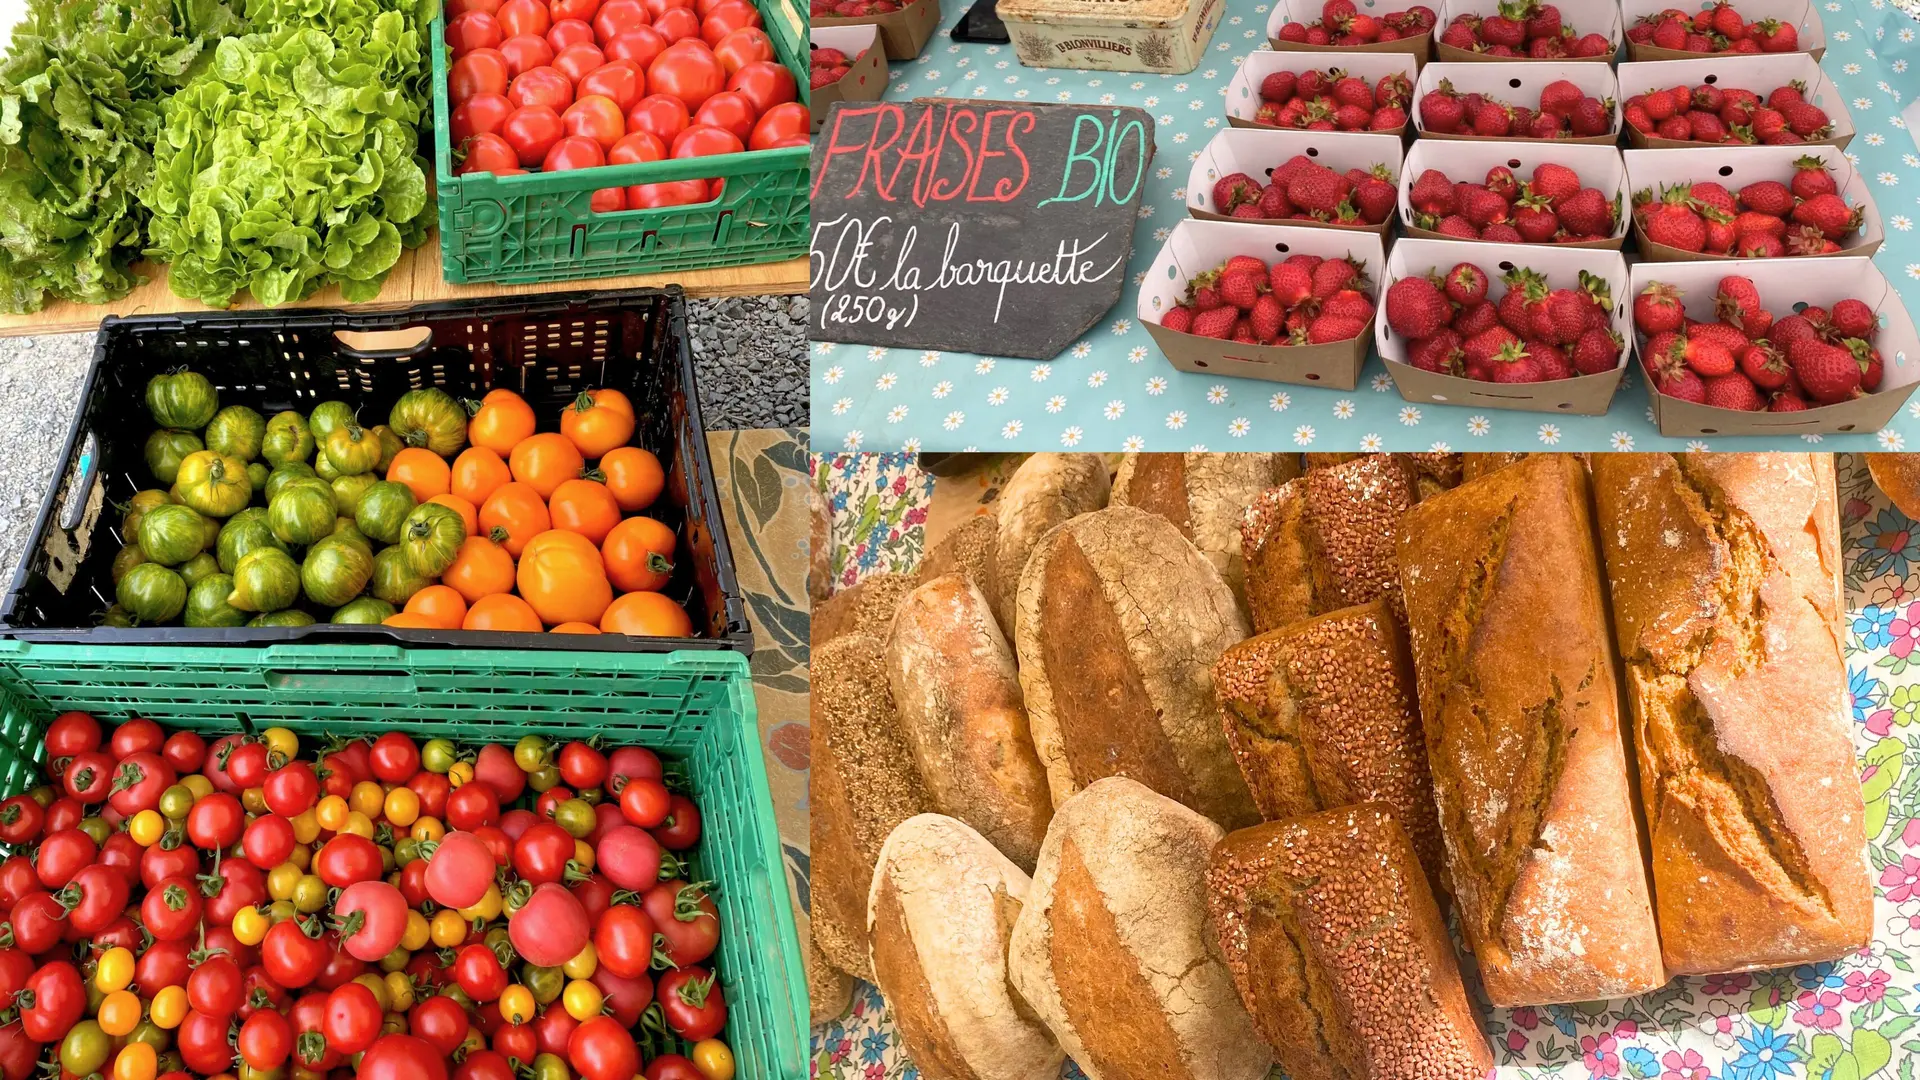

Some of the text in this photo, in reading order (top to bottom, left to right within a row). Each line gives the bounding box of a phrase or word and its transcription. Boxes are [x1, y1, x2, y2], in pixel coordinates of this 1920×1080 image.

[1063, 39, 1132, 56] BLONVILLIERS
[810, 102, 1036, 208] FRAISES
[879, 225, 922, 291] la
[923, 222, 1123, 323] barquette
[820, 293, 919, 331] (250g)
